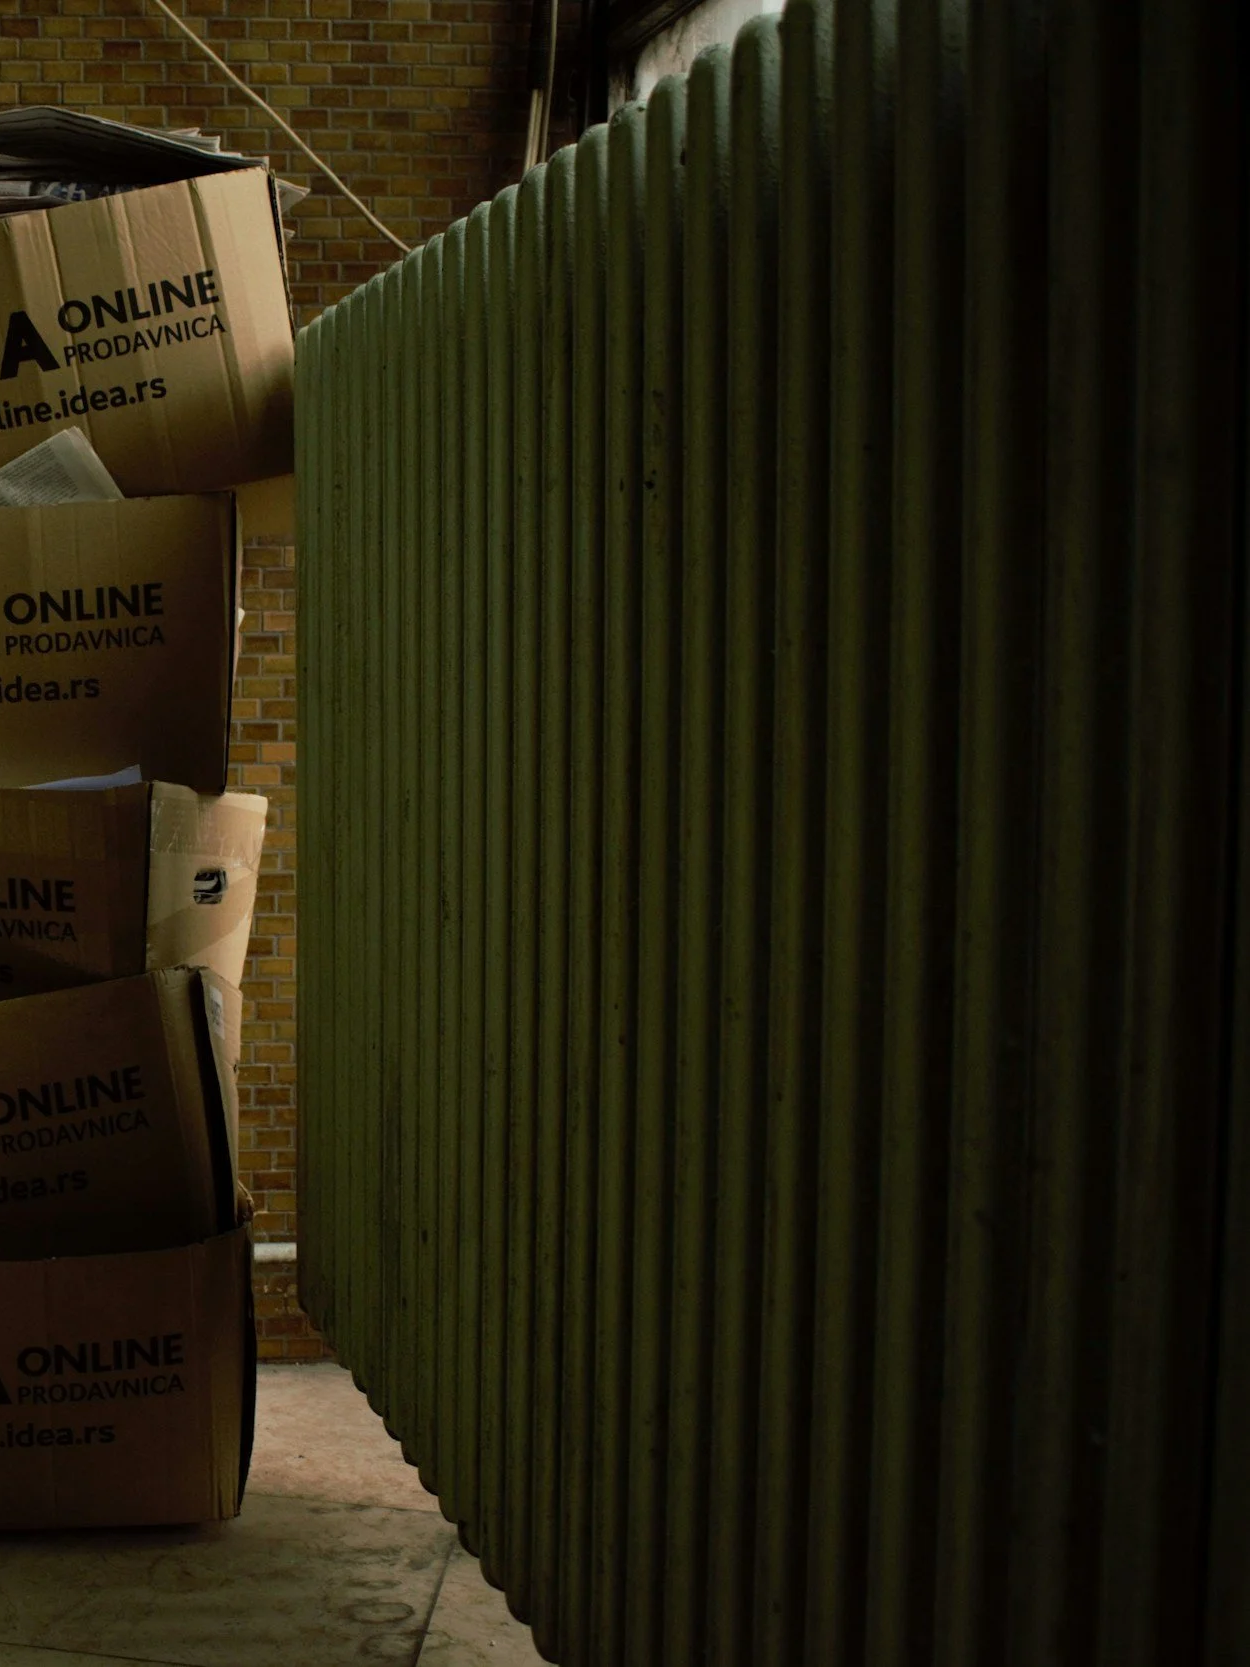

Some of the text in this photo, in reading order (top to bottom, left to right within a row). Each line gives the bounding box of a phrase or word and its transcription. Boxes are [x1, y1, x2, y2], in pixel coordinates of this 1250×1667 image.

[57, 269, 220, 334] ONLINE
[62, 313, 226, 368] PRODAVNICA
[3, 582, 165, 626] ONLINE
[4, 625, 166, 656] PRODAVNICA
[16, 1333, 185, 1377] ONLINE
[17, 1374, 186, 1405] PRODAVNICA
